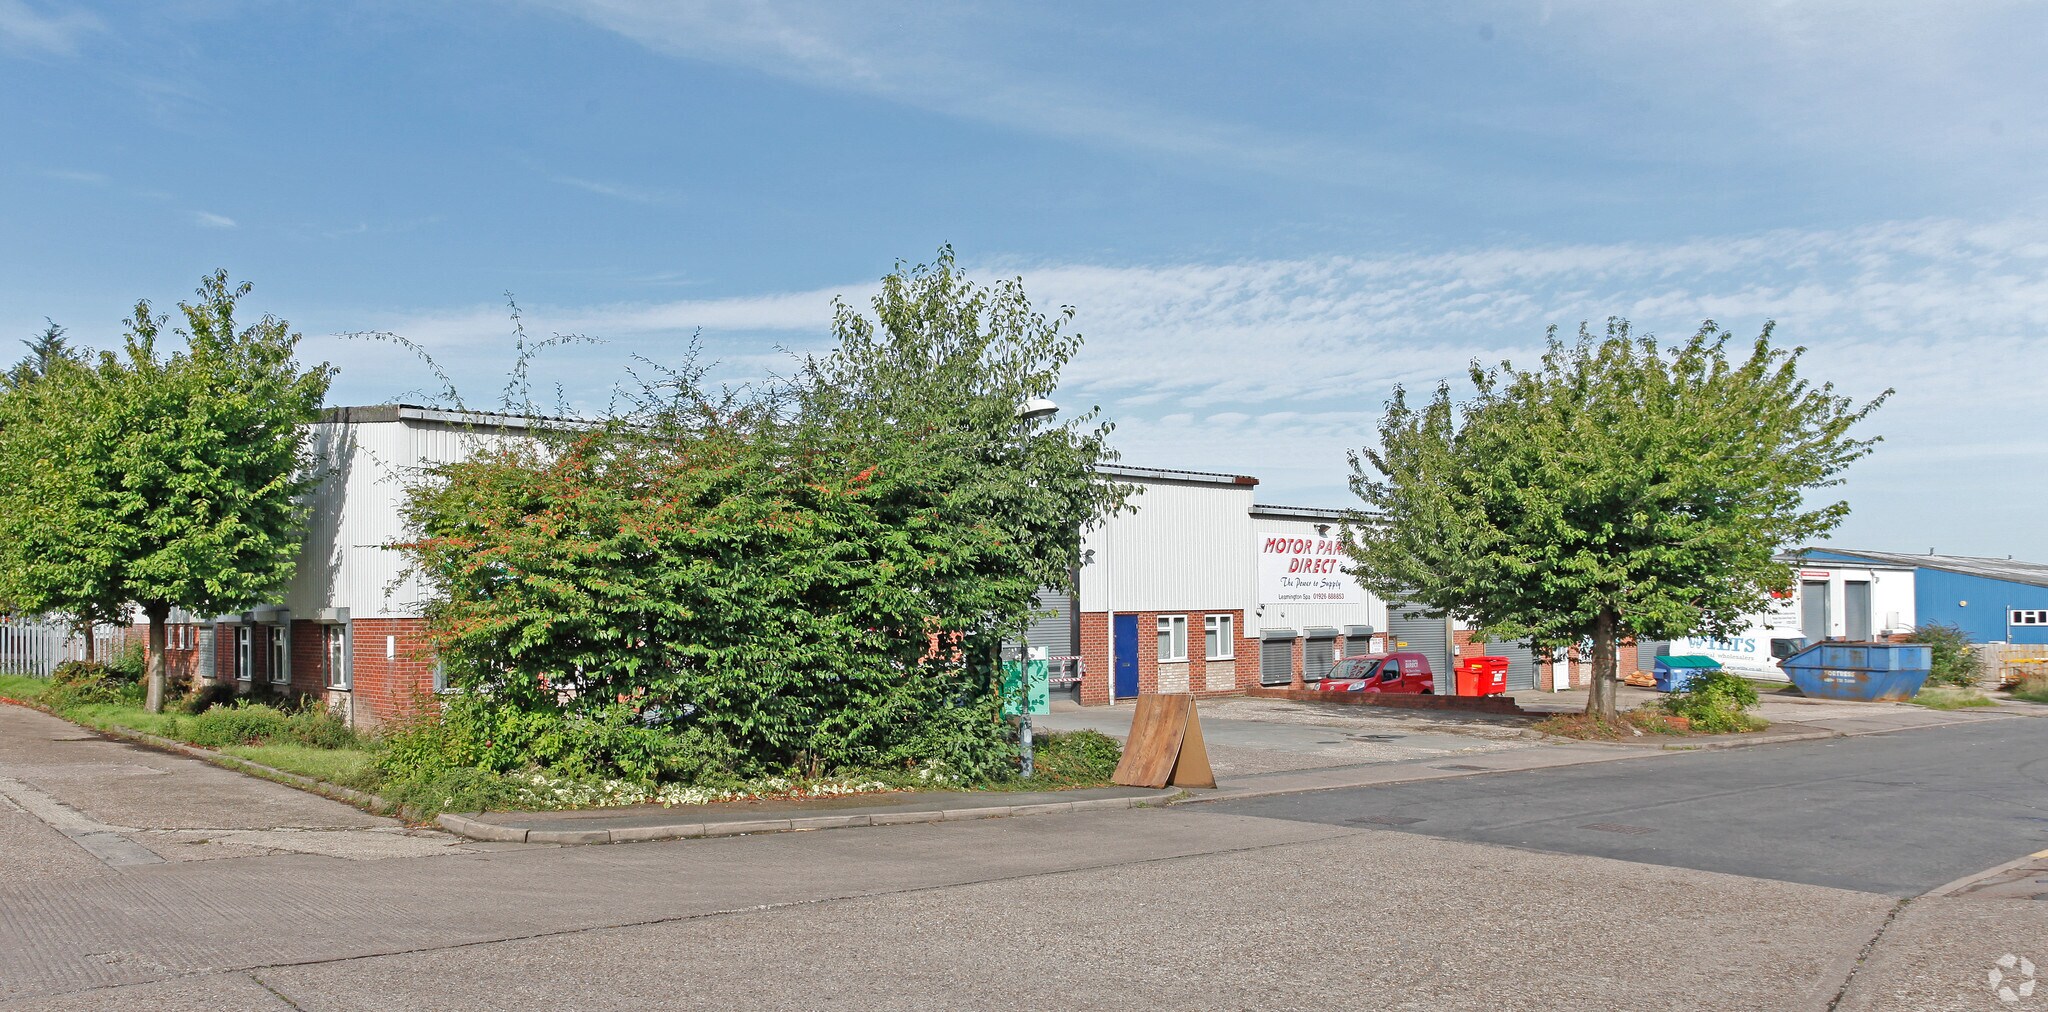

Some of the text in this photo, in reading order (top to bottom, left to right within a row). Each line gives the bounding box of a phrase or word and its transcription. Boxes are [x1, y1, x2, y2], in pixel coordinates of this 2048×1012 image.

[1263, 538, 1313, 554] MOTOR
[1288, 557, 1337, 574] DIRECT
[1280, 576, 1342, 590] The Power to Supply
[1278, 593, 1302, 601] Leamington
[1303, 593, 1311, 601] Spa
[1688, 636, 1756, 653] WILTS
[1717, 652, 1755, 661] wholesalers
